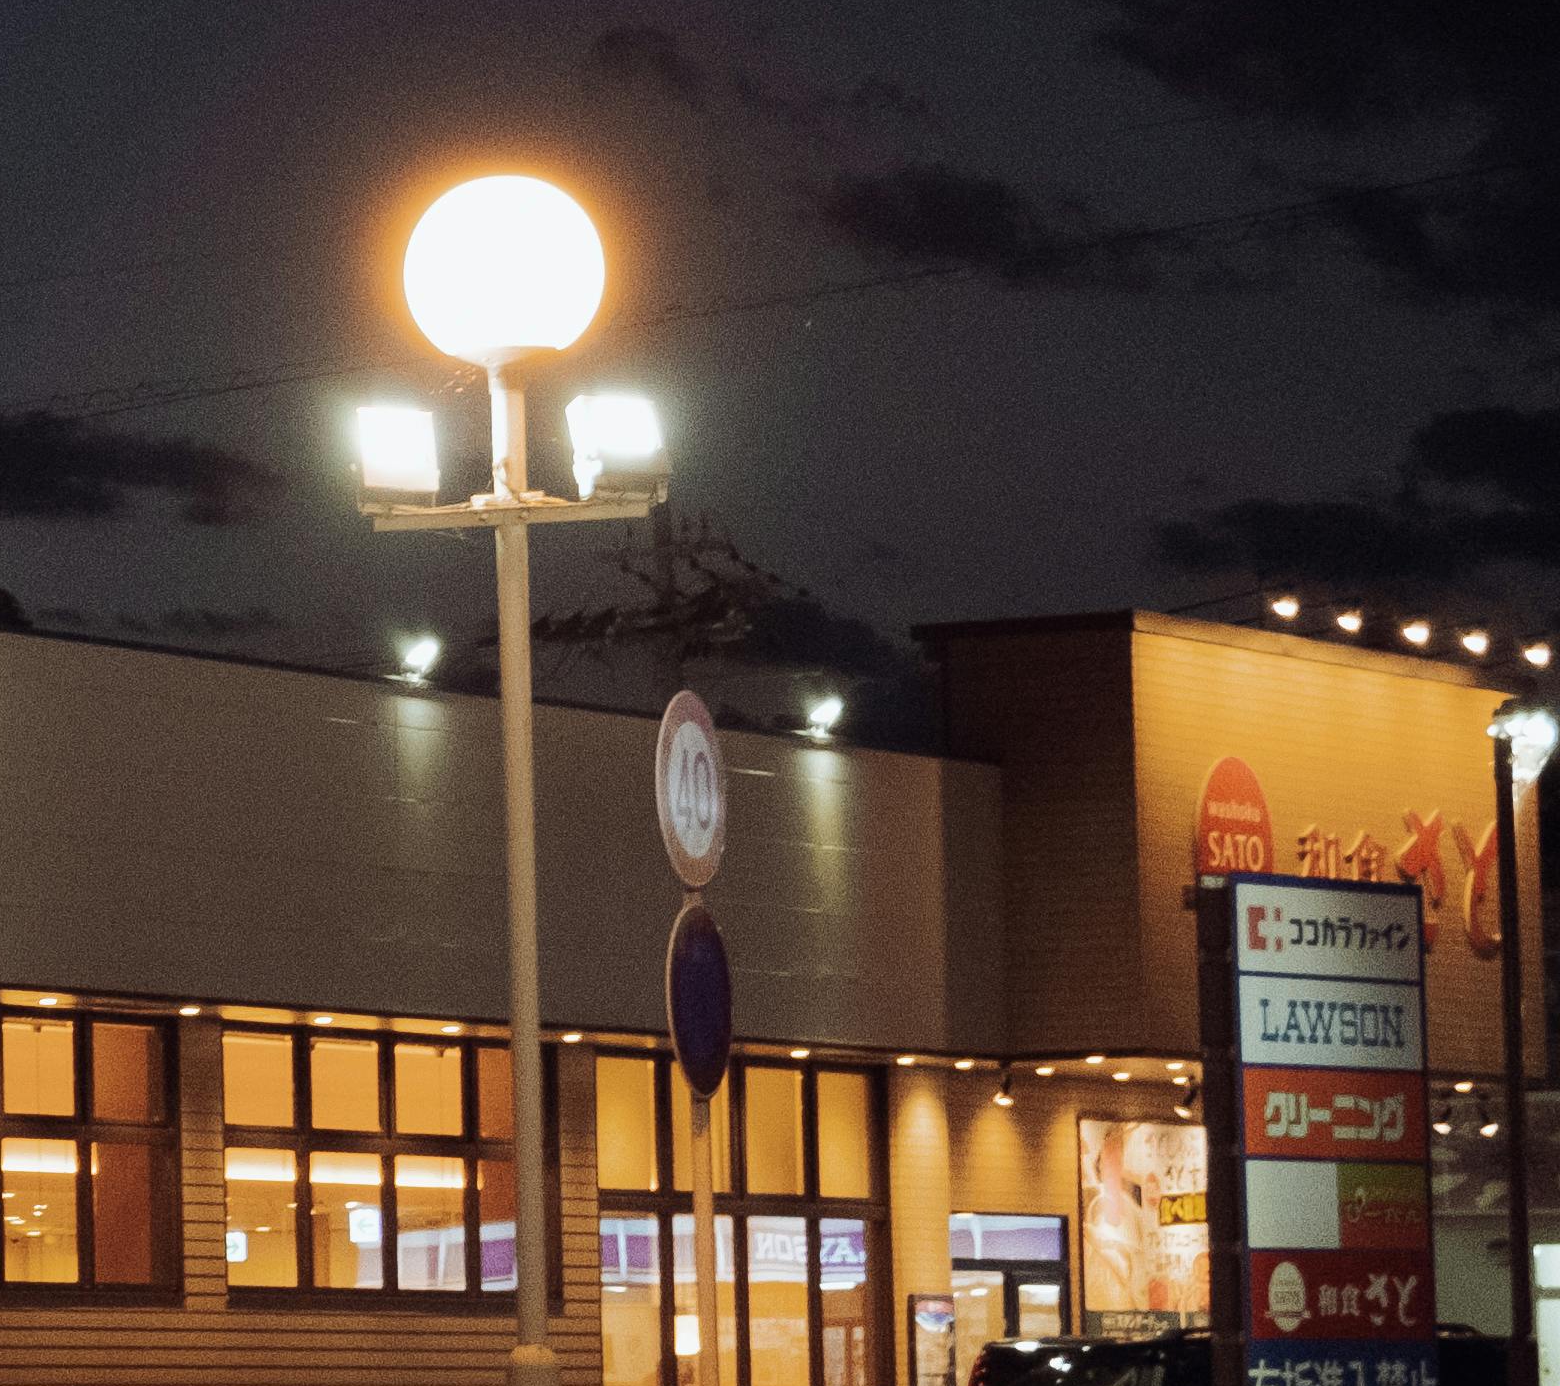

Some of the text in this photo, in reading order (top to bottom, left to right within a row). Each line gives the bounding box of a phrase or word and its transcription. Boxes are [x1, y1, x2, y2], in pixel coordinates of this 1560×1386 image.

[1207, 830, 1265, 872] SATO
[1259, 997, 1406, 1049] LAWSON
[1264, 1090, 1406, 1143] クリーニング
